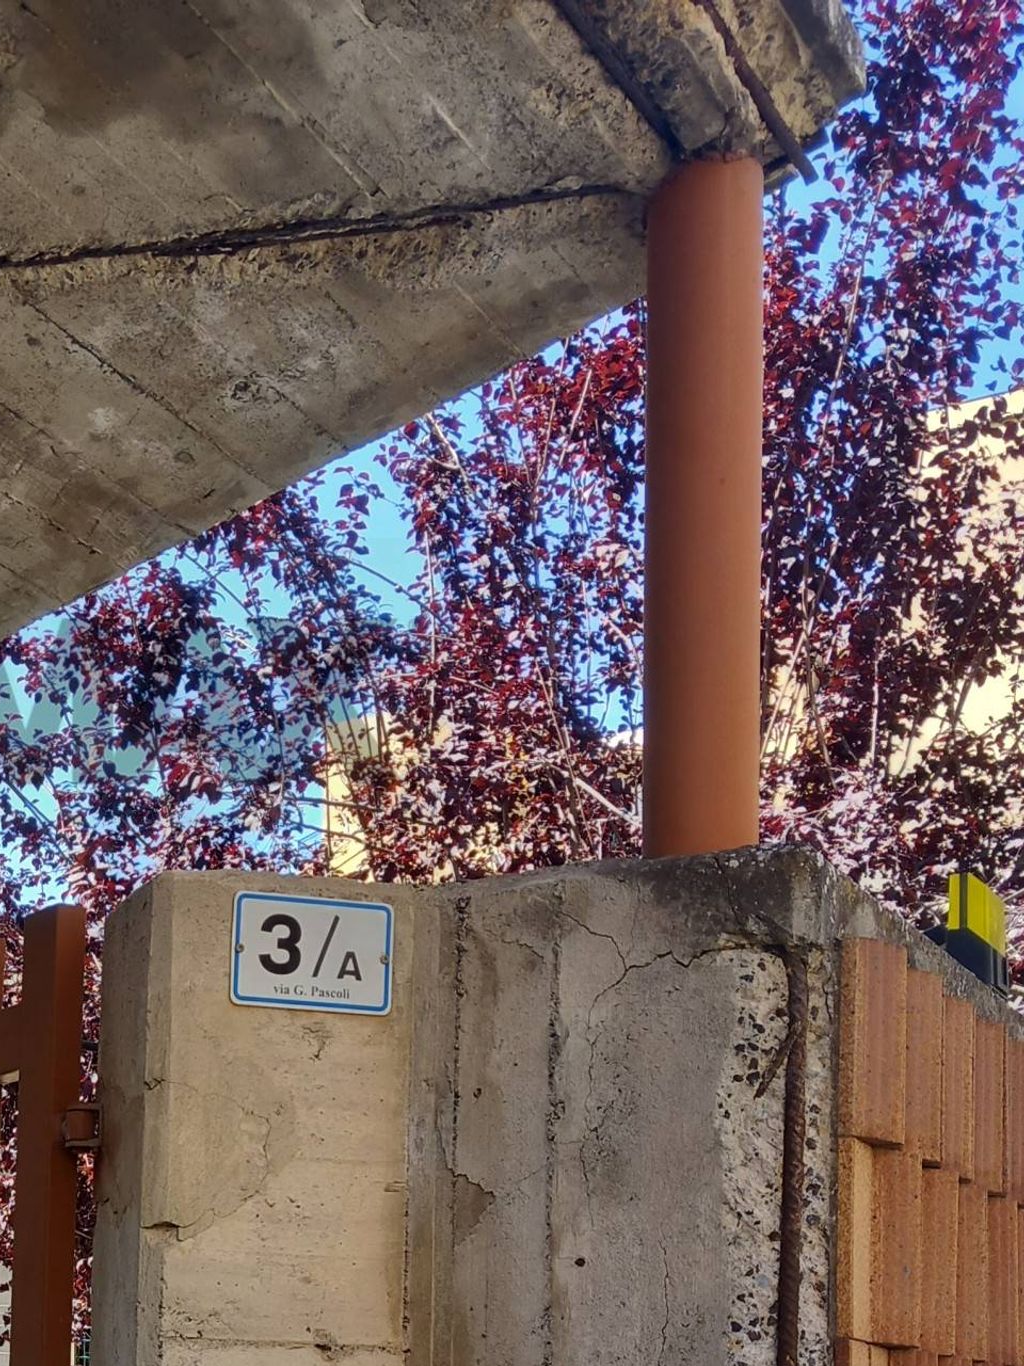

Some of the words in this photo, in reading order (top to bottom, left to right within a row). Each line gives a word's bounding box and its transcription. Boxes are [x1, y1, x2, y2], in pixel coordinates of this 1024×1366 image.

[258, 913, 362, 981] 3/A
[273, 984, 290, 995] via
[294, 985, 307, 996] G.
[311, 986, 350, 999] Pascoli
